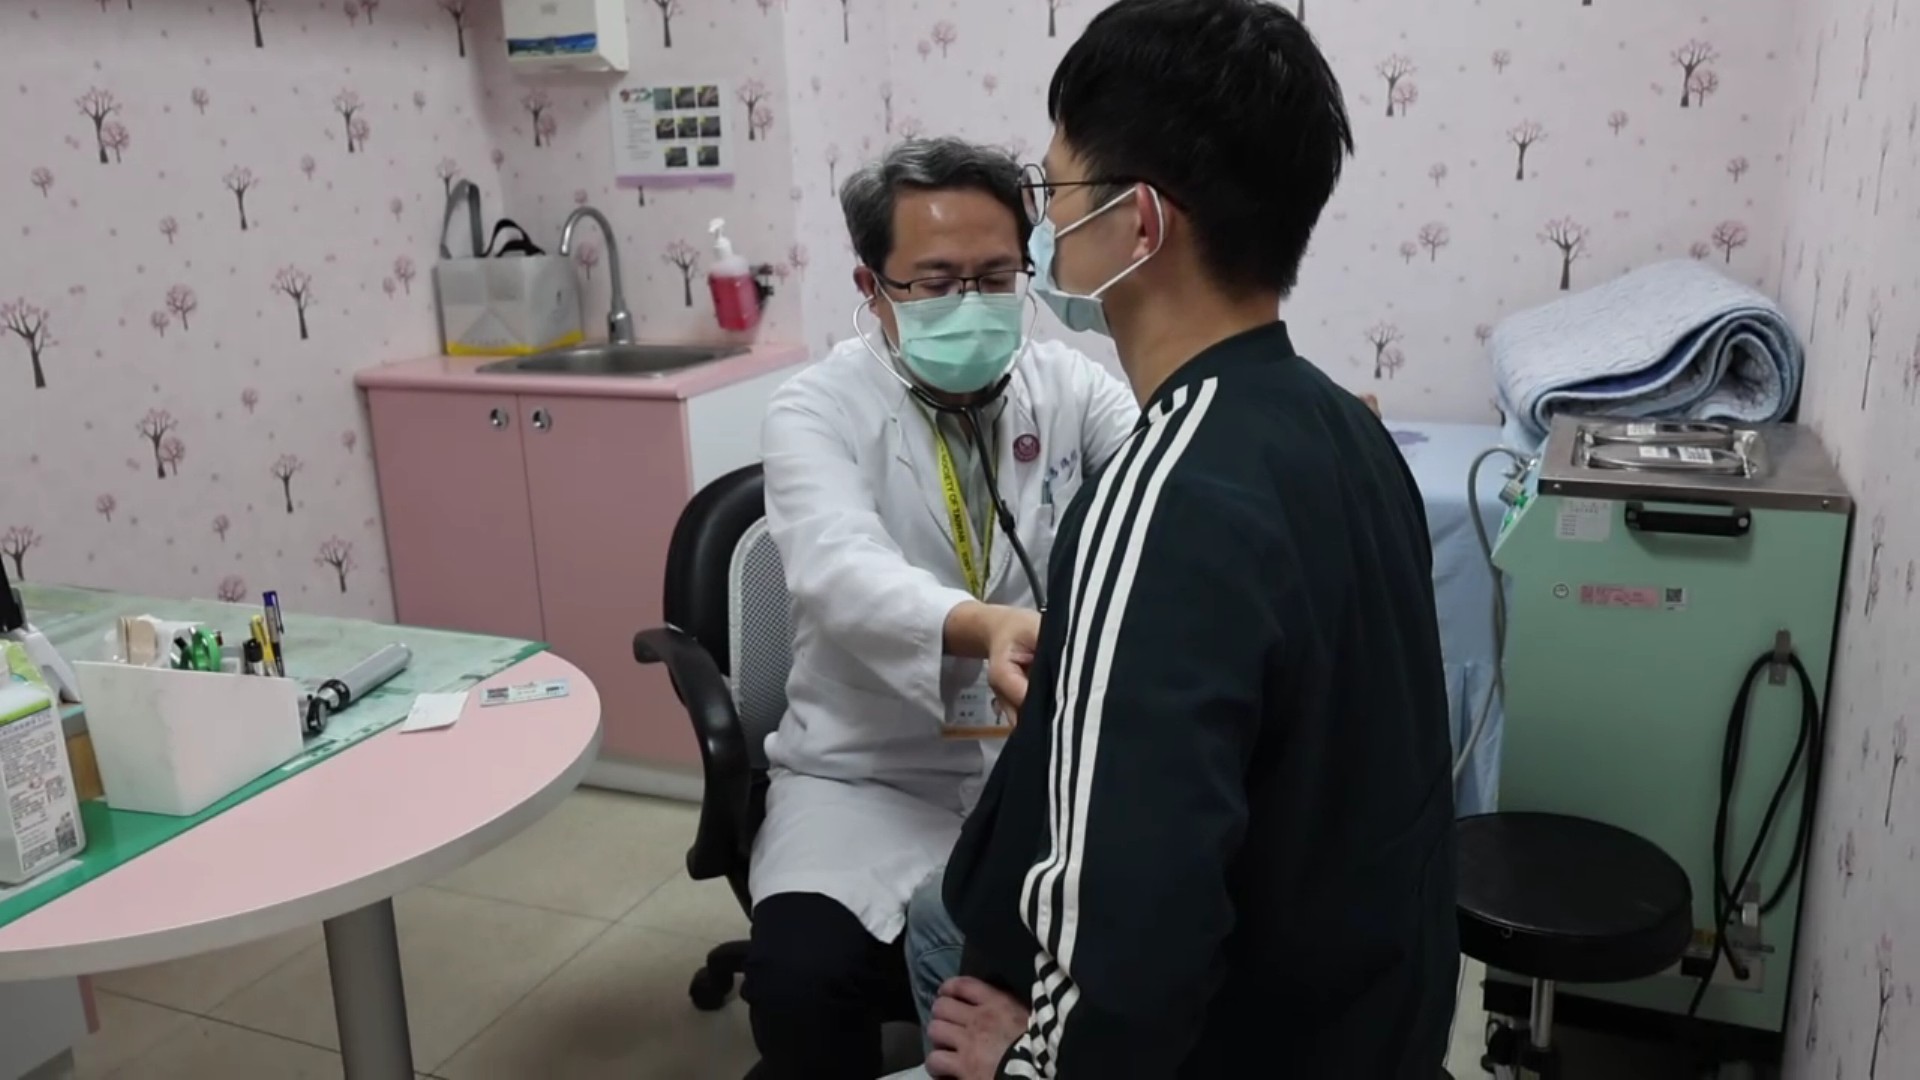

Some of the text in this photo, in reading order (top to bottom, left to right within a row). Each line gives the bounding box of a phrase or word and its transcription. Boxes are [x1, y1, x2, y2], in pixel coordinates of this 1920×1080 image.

[941, 455, 966, 543] SOCIETY OF TAIWAN
